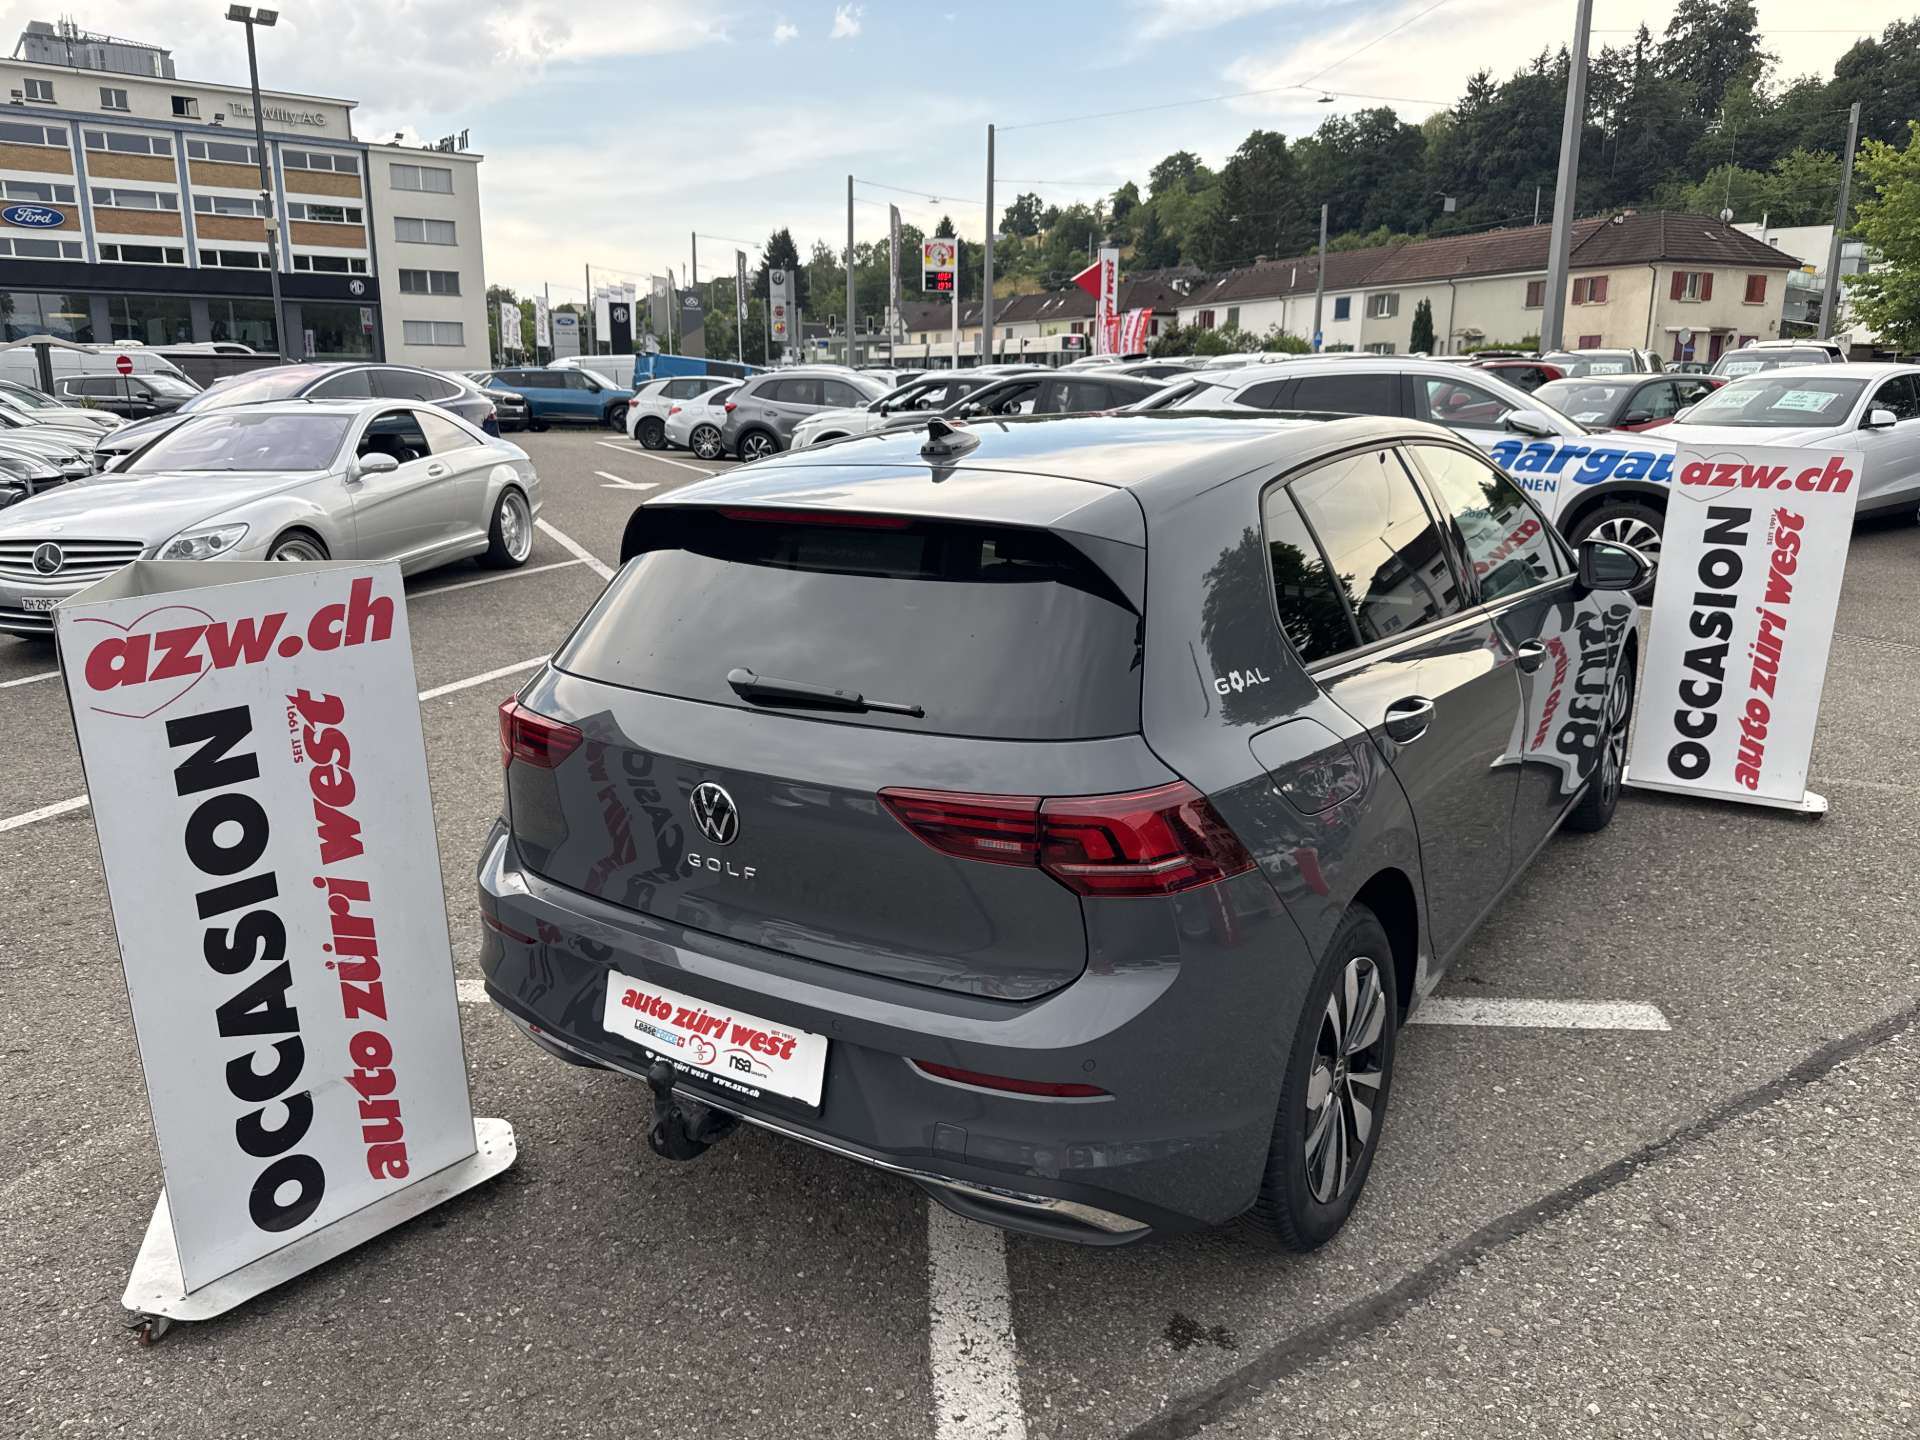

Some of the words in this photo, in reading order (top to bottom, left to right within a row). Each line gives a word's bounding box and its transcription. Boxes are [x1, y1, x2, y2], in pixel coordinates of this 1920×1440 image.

[261, 104, 297, 127] Willy
[303, 111, 327, 127] AG
[15, 207, 53, 224] Ford
[1680, 457, 1853, 494] azw.ch
[1764, 506, 1805, 604] west
[84, 577, 395, 691] azw.ch
[1667, 505, 1752, 780] OCCASION
[1747, 606, 1788, 700] züri
[286, 704, 301, 738] 1991
[1214, 667, 1271, 695] GOAL
[285, 688, 365, 866] west
[292, 738, 304, 764] SEIT
[1735, 697, 1771, 791] auto
[687, 853, 757, 880] GOLF
[165, 705, 326, 1233] OCCASION
[312, 875, 388, 1022] züri
[621, 987, 672, 1020] auto
[671, 1007, 732, 1040] züri
[730, 1023, 797, 1061] west
[728, 1054, 752, 1074] nsa
[343, 1030, 410, 1180] auto
